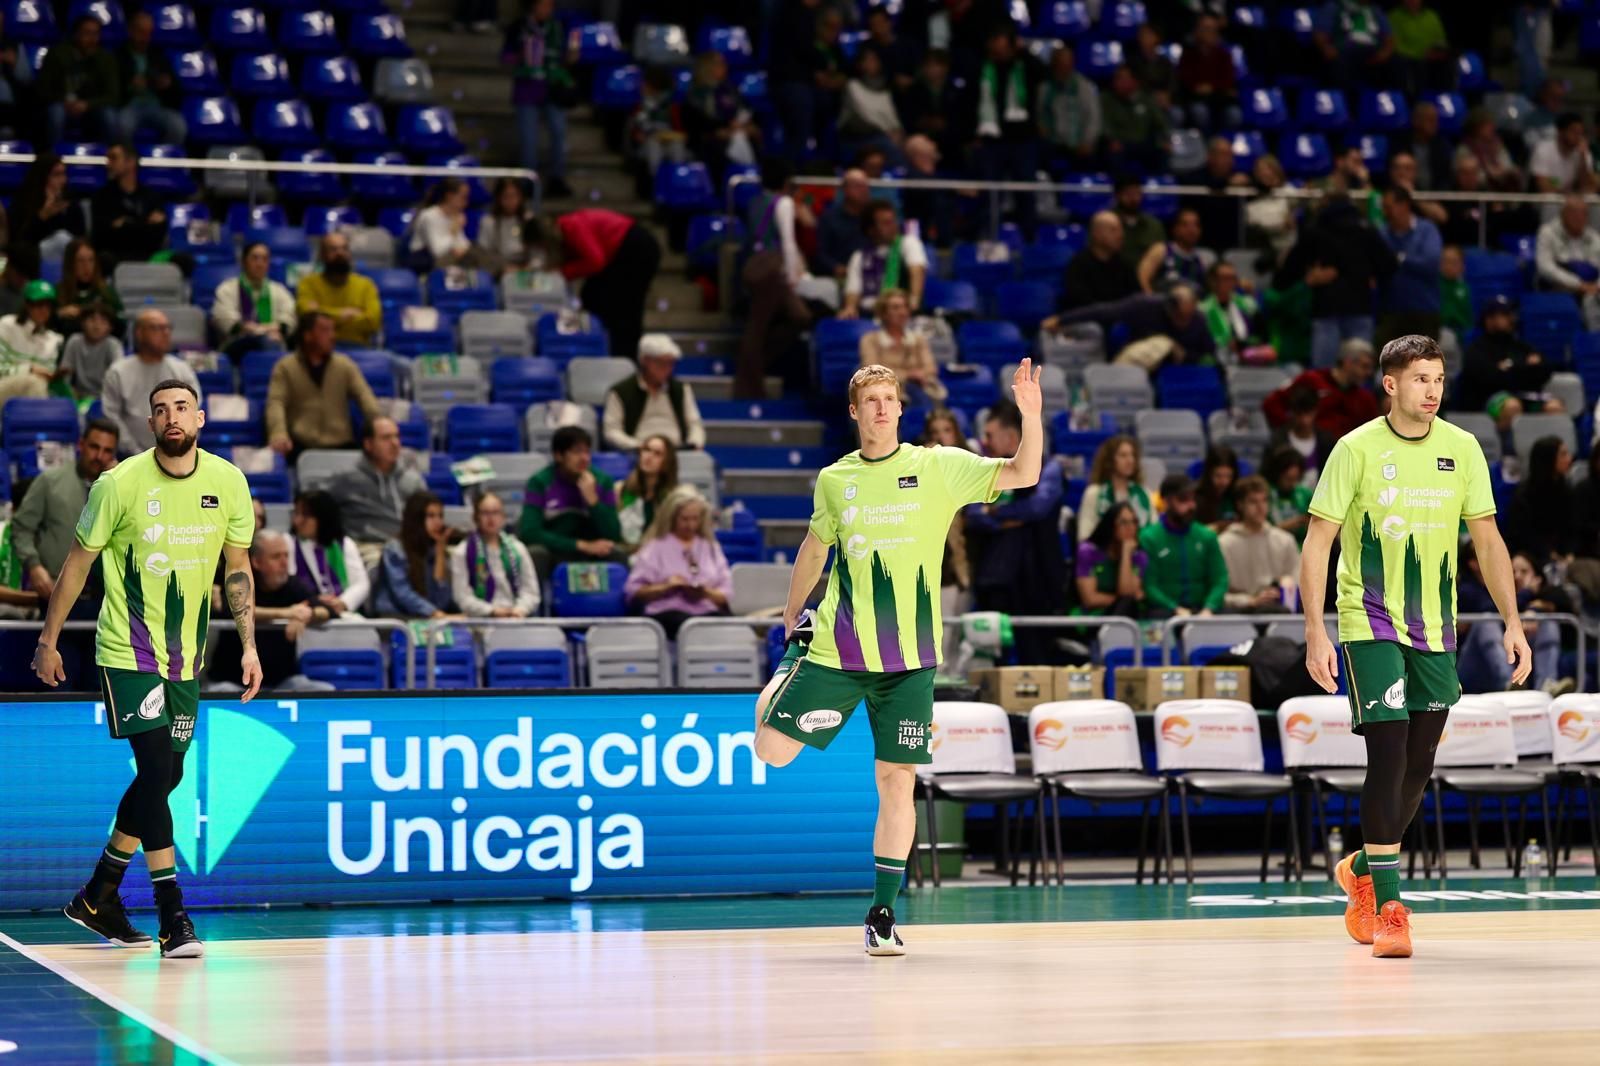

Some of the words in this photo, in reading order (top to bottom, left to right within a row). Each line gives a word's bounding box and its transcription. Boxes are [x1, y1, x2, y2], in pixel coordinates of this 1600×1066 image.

[863, 502, 921, 514] Fundación
[1403, 497, 1442, 508] Unicaja
[863, 513, 905, 525] Unicaja
[168, 534, 205, 546] Unicaja
[898, 718, 918, 727] sabor
[171, 725, 193, 742] laga
[903, 723, 925, 737] má
[897, 732, 924, 750] laga
[327, 712, 768, 792] Fundación
[327, 795, 645, 892] Unicaja
